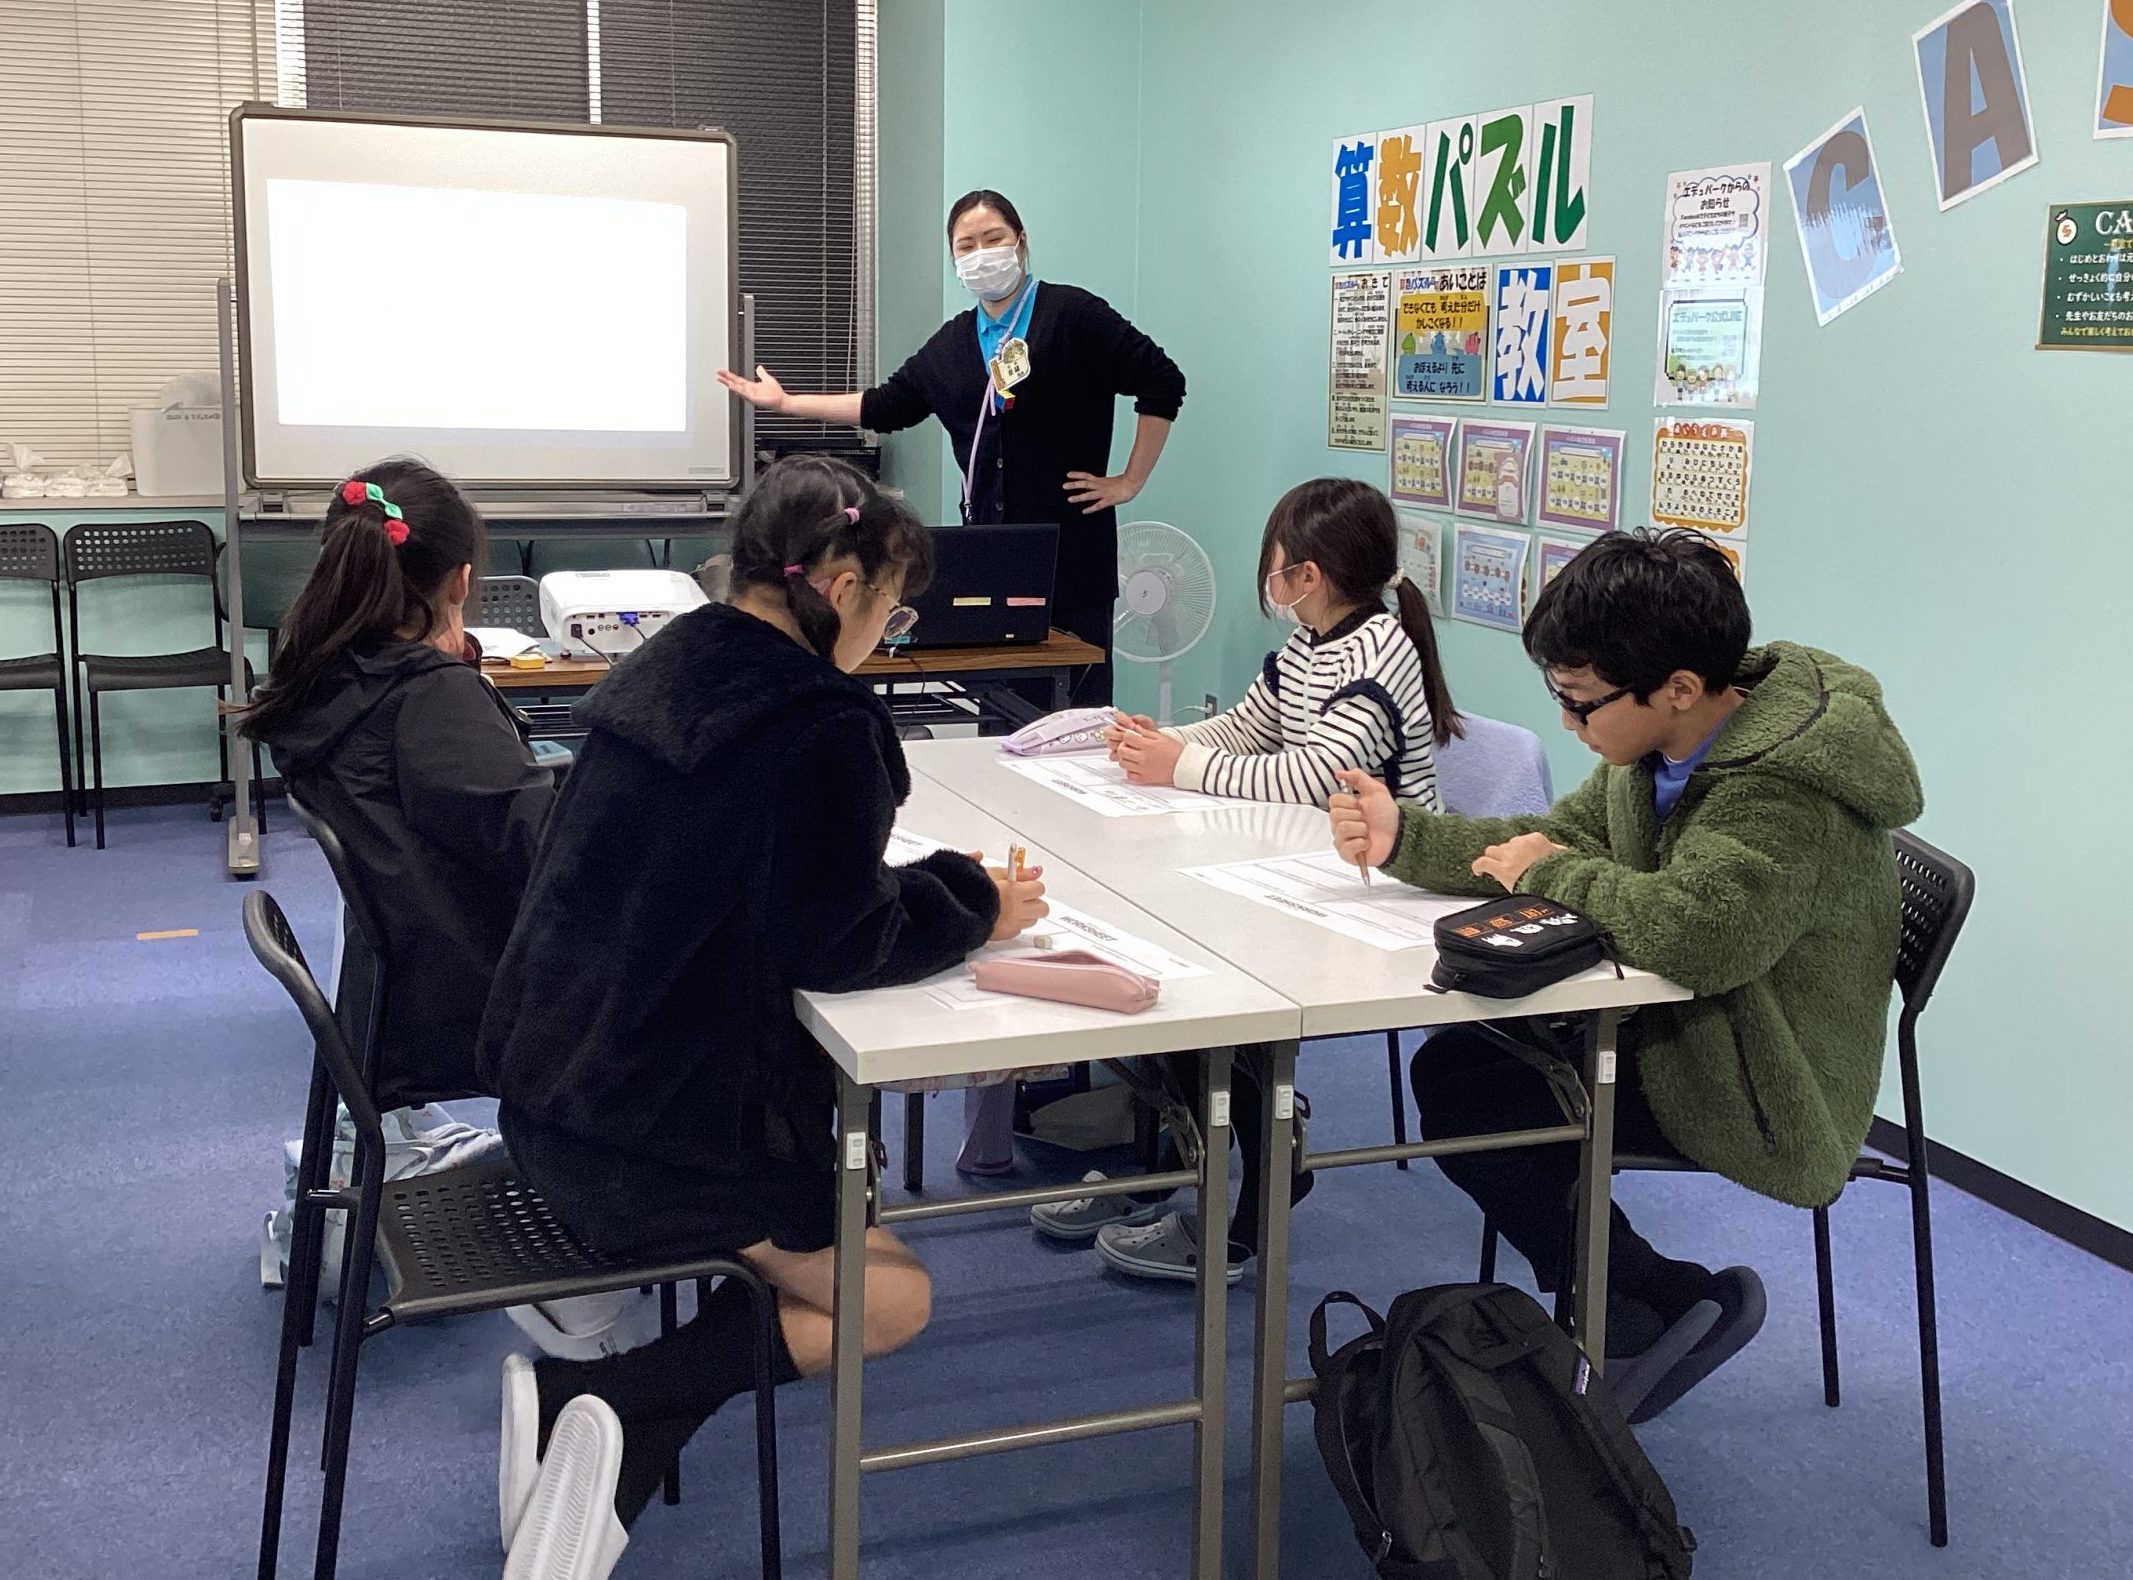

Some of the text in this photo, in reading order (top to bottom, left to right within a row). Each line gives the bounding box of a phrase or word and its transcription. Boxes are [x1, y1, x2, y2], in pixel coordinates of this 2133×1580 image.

[1332, 105, 1586, 259] 算数パズル
[1700, 197, 1730, 210] お知らせ
[2068, 271, 2133, 283] せっきょく的に自分
[1403, 300, 1481, 314] できなくても 考えた分だけ
[1495, 264, 1609, 402] 教室
[1414, 361, 1465, 375] おぼえるより 先に
[1406, 380, 1436, 393] 考える人に
[1059, 915, 1118, 942] WORKSHEET
